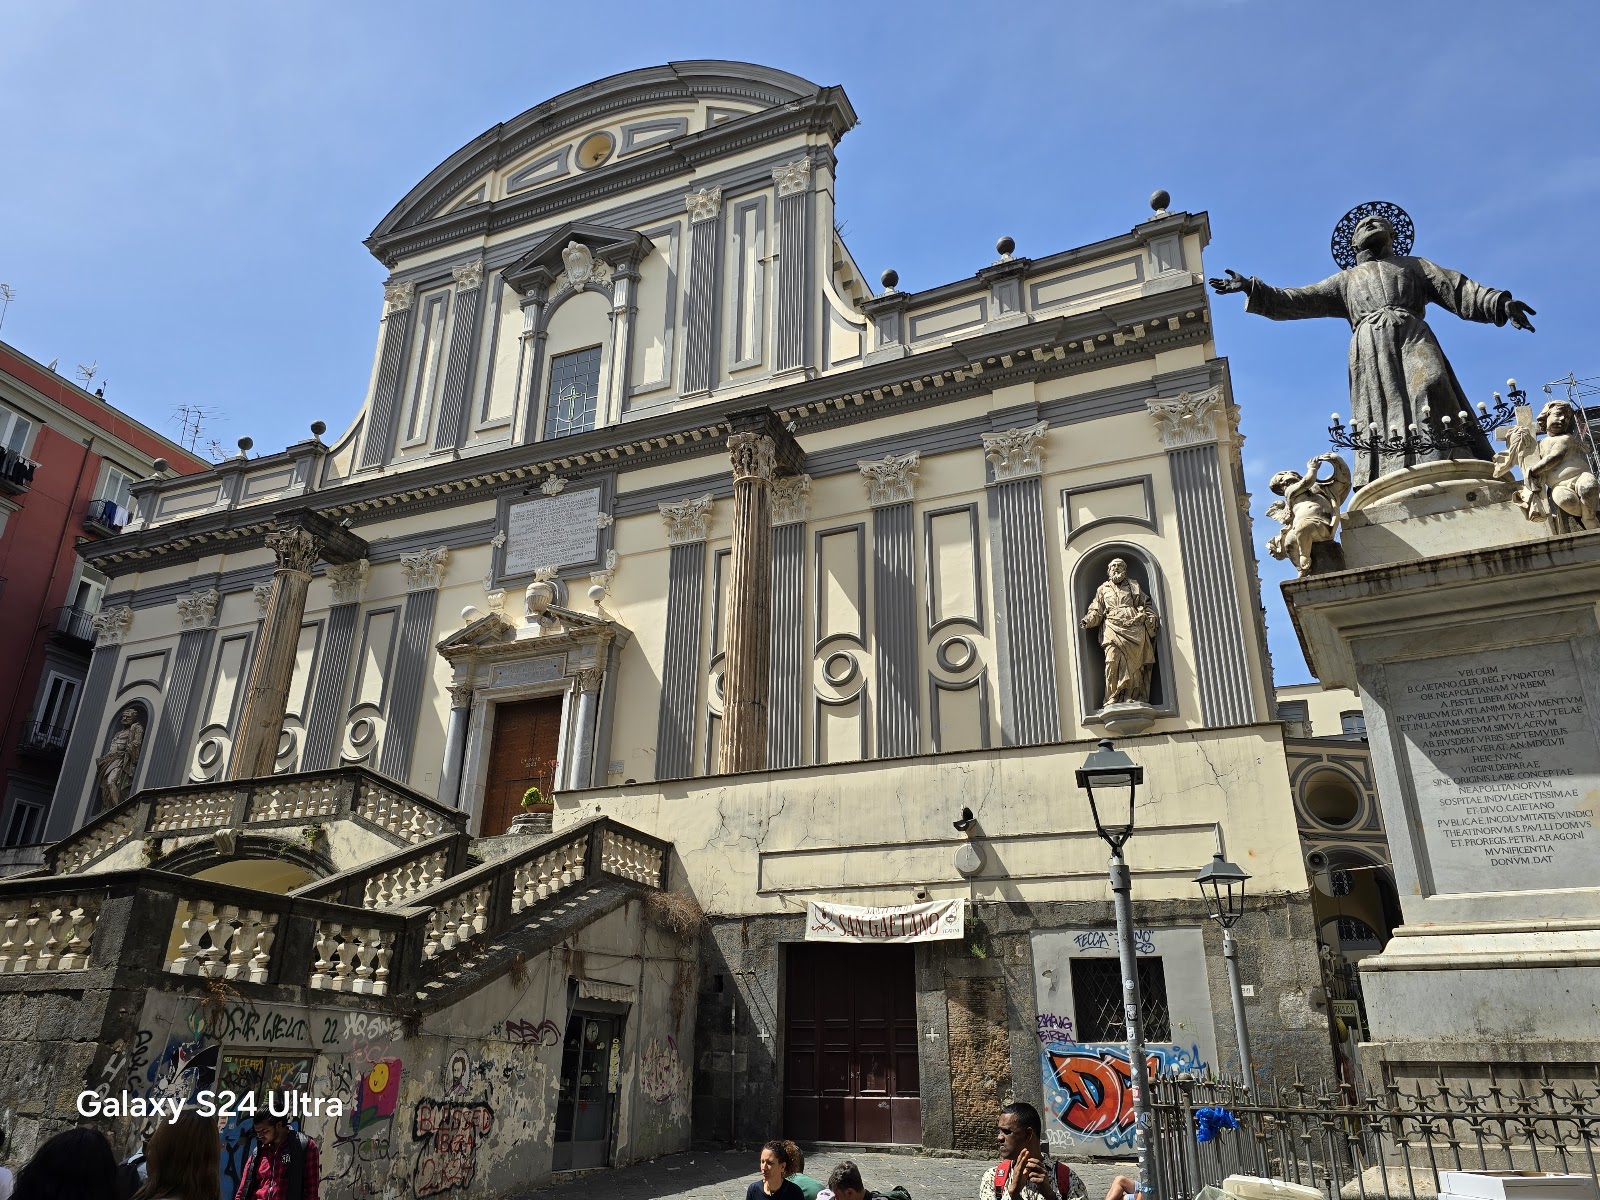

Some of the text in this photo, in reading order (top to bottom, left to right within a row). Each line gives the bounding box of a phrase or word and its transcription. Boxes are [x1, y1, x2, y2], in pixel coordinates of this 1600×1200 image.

[838, 912, 940, 938] SAN GAETANO
[420, 1105, 492, 1132] BLESSED
